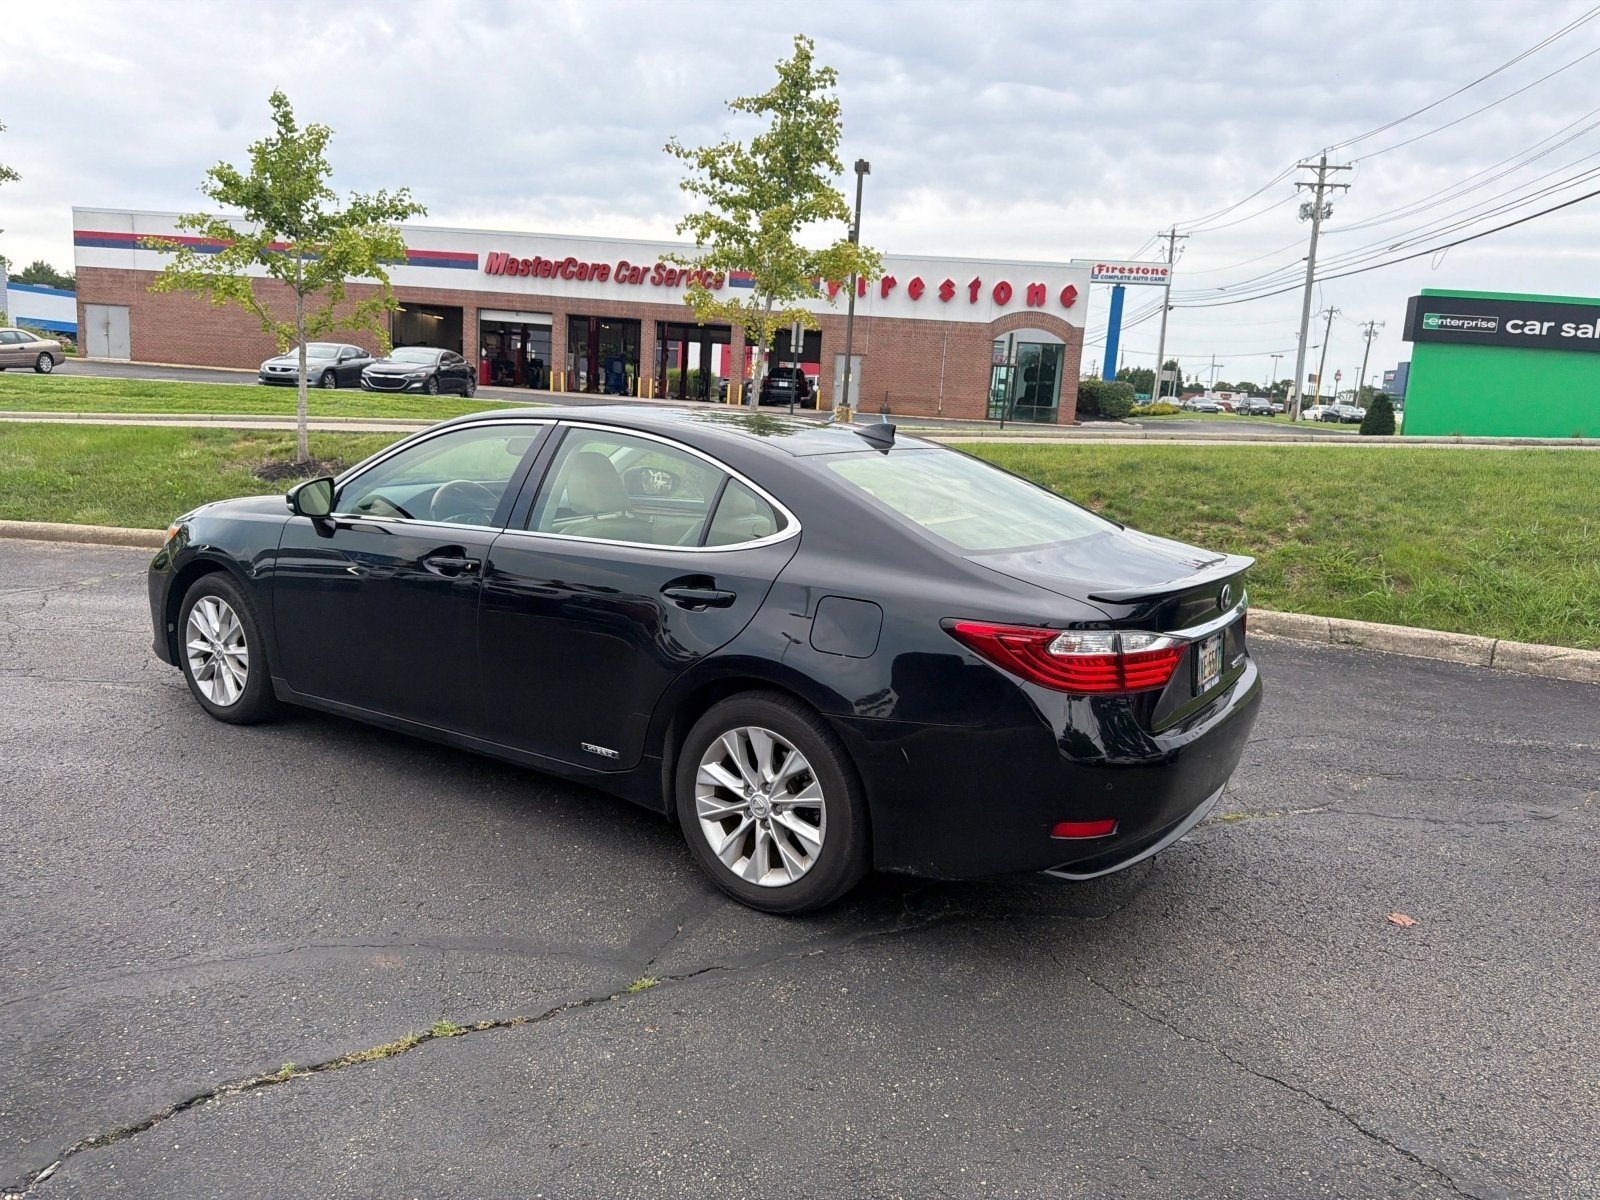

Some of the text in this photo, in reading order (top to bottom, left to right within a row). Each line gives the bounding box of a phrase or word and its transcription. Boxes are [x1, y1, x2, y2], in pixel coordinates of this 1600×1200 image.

[484, 252, 726, 290] MasterCare Car Service
[1096, 263, 1168, 276] Firestone
[1428, 316, 1496, 329] enterprise
[1505, 319, 1555, 336] car
